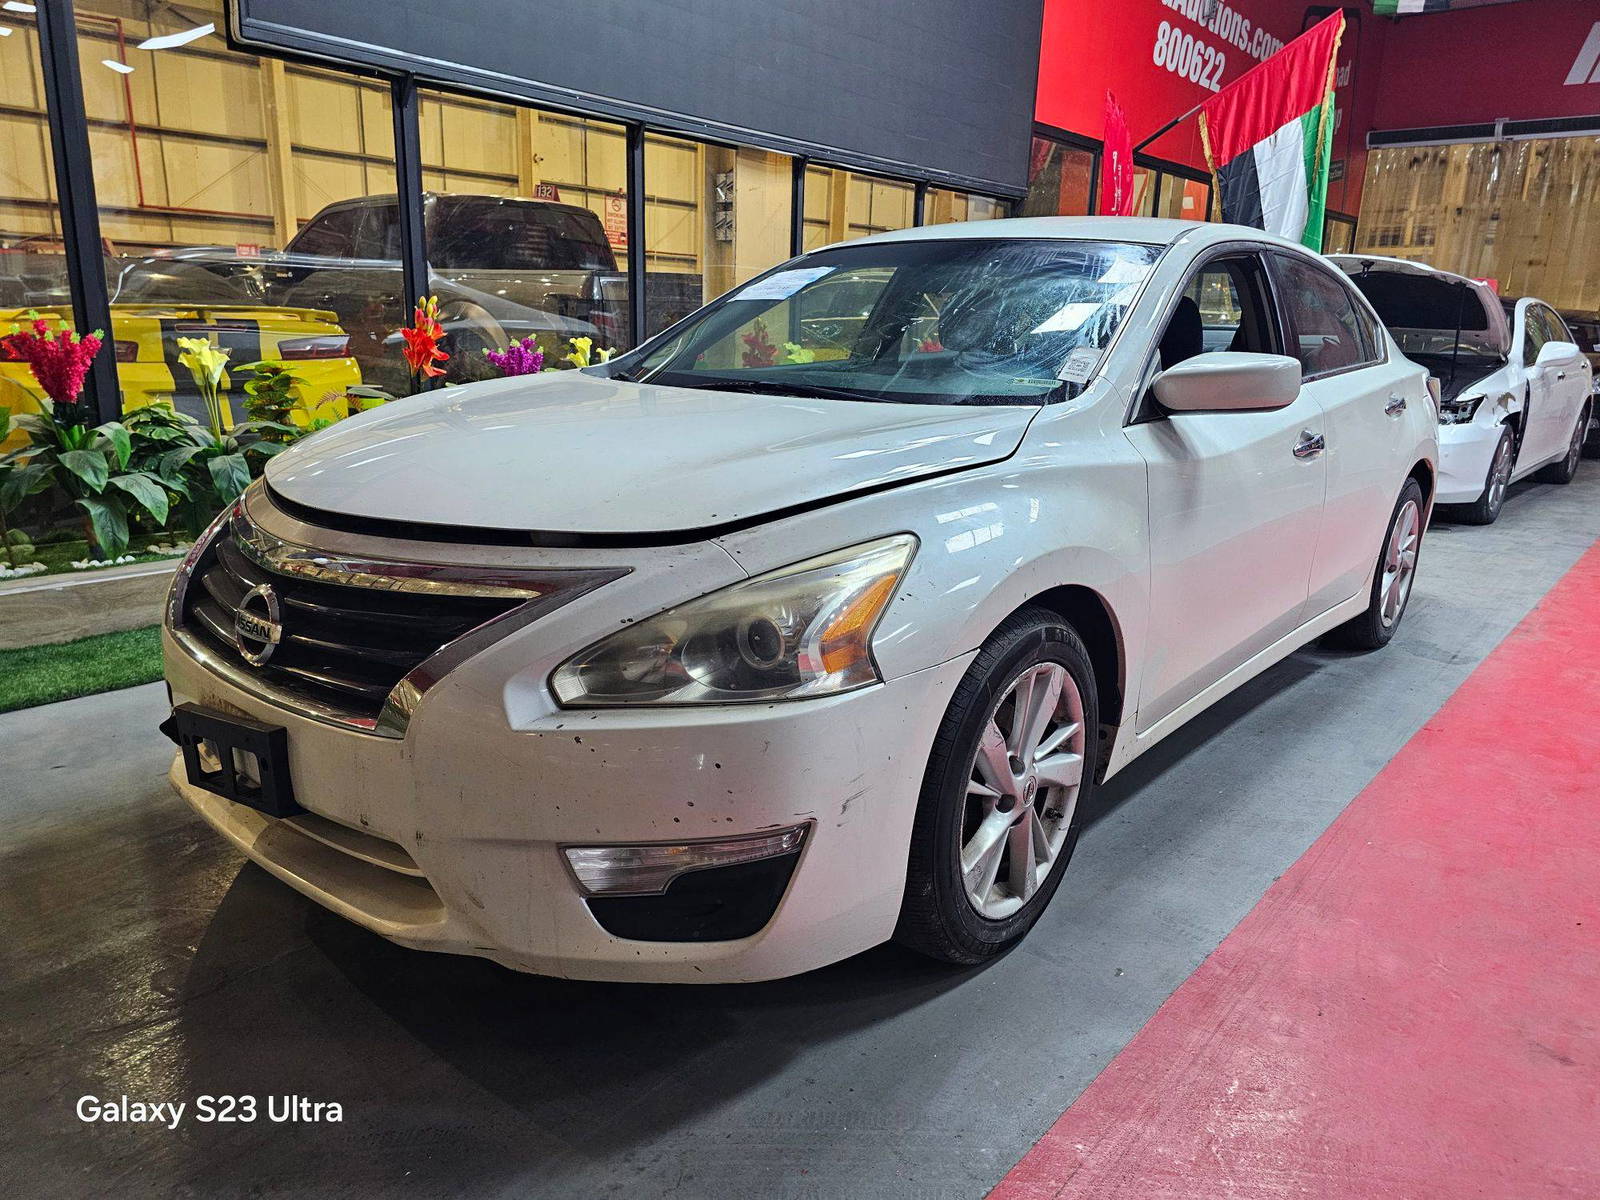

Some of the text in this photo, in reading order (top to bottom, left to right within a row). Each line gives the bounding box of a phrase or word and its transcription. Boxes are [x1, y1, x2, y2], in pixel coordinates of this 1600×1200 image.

[1153, 20, 1226, 93] 800622
[537, 186, 552, 198] 132
[237, 614, 271, 639] SSAN
